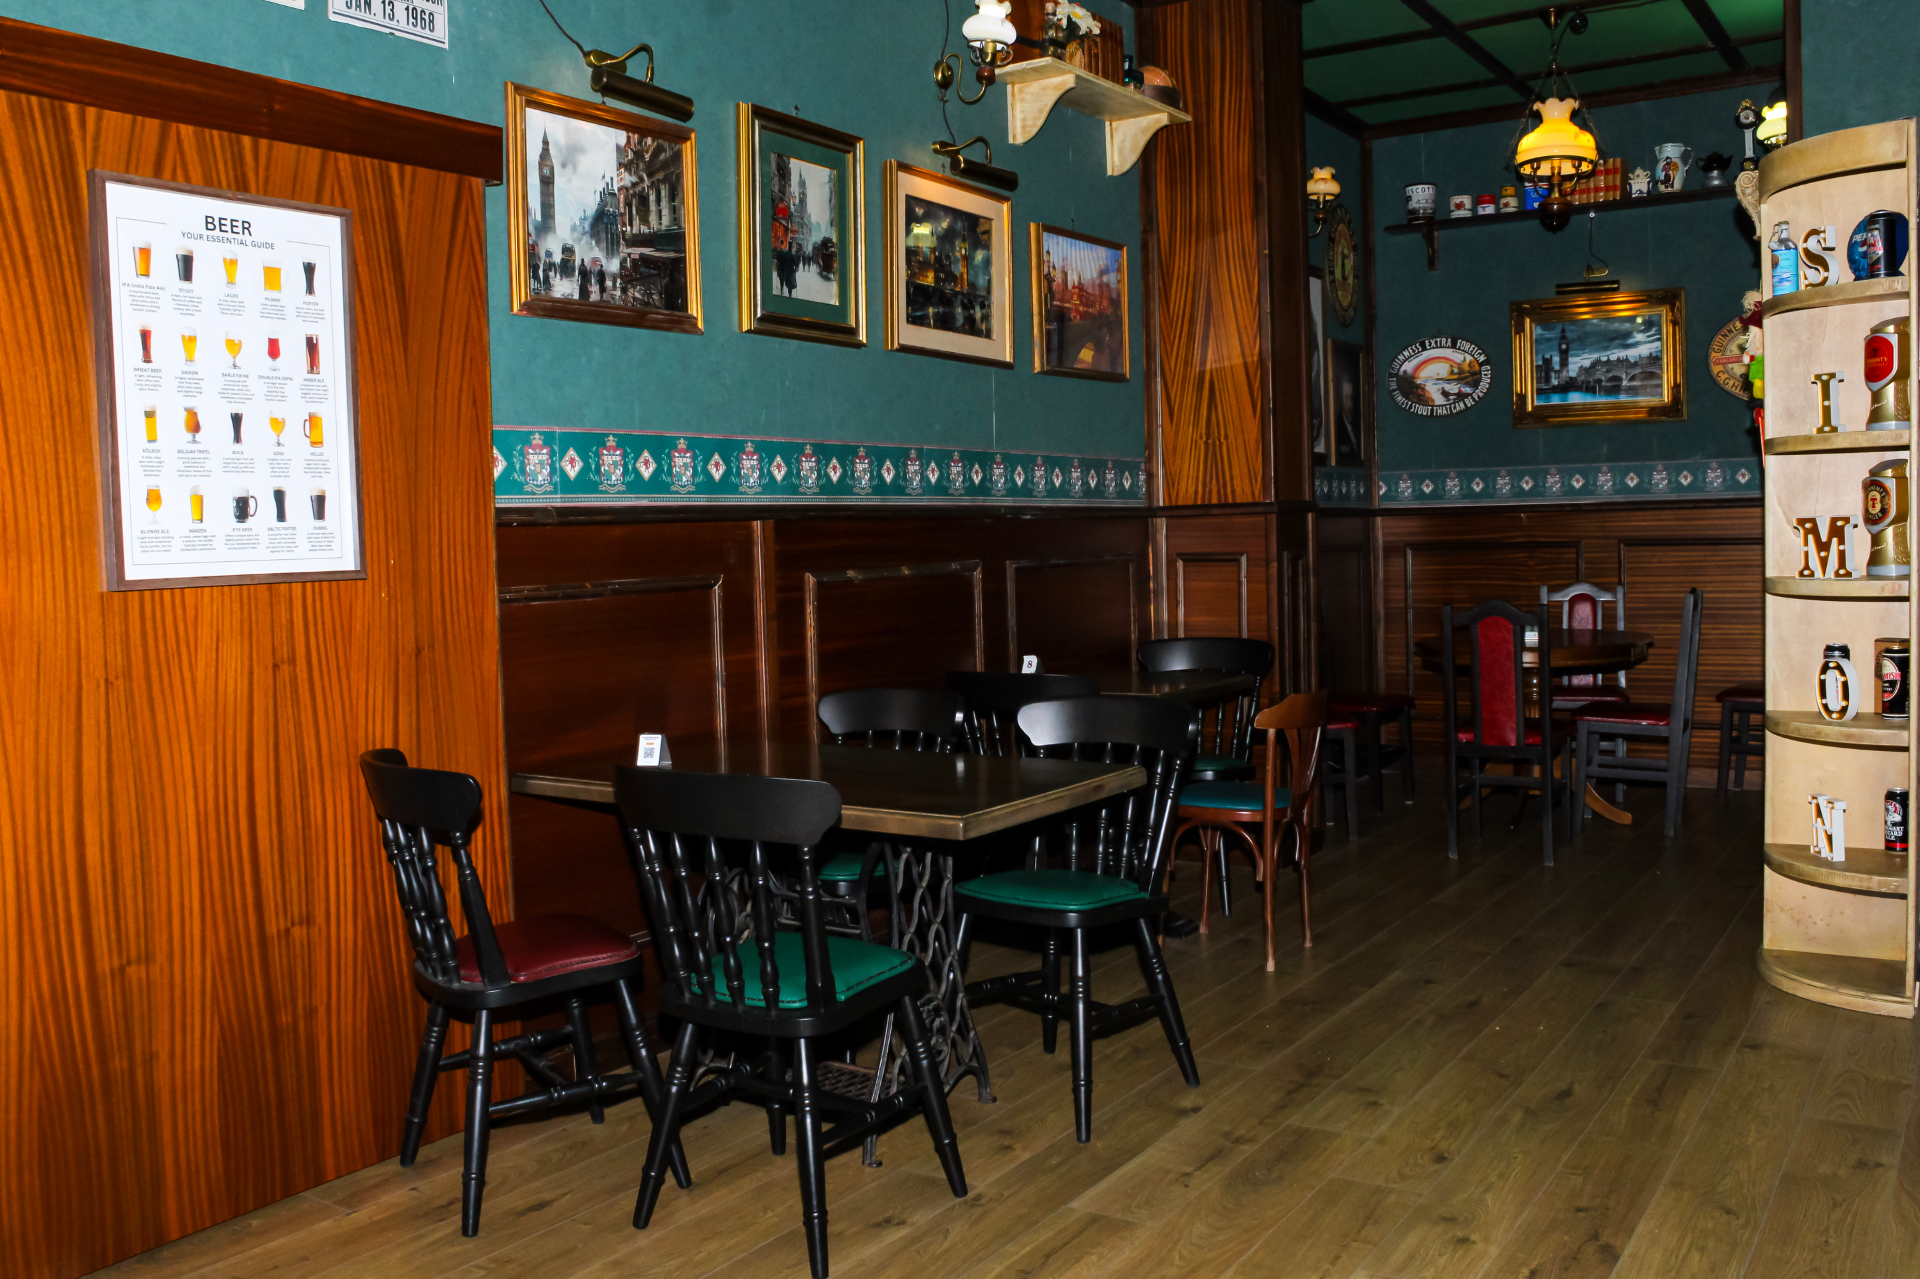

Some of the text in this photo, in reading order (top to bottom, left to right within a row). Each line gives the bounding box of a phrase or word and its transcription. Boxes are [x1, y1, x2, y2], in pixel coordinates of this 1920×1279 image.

[404, 5, 435, 33] 1968
[205, 215, 252, 237] BEER
[1851, 233, 1867, 243] PEP
[181, 231, 275, 250] YOUR ESSENTIAL GUIDE
[1713, 322, 1741, 354] GUINNE
[1390, 342, 1422, 374] GUINNESS
[1425, 337, 1452, 349] EXTRA
[1456, 339, 1487, 363] FOREIGN
[1389, 365, 1492, 416] THE FINEST STOUT THAT CAN BE PRODUCED
